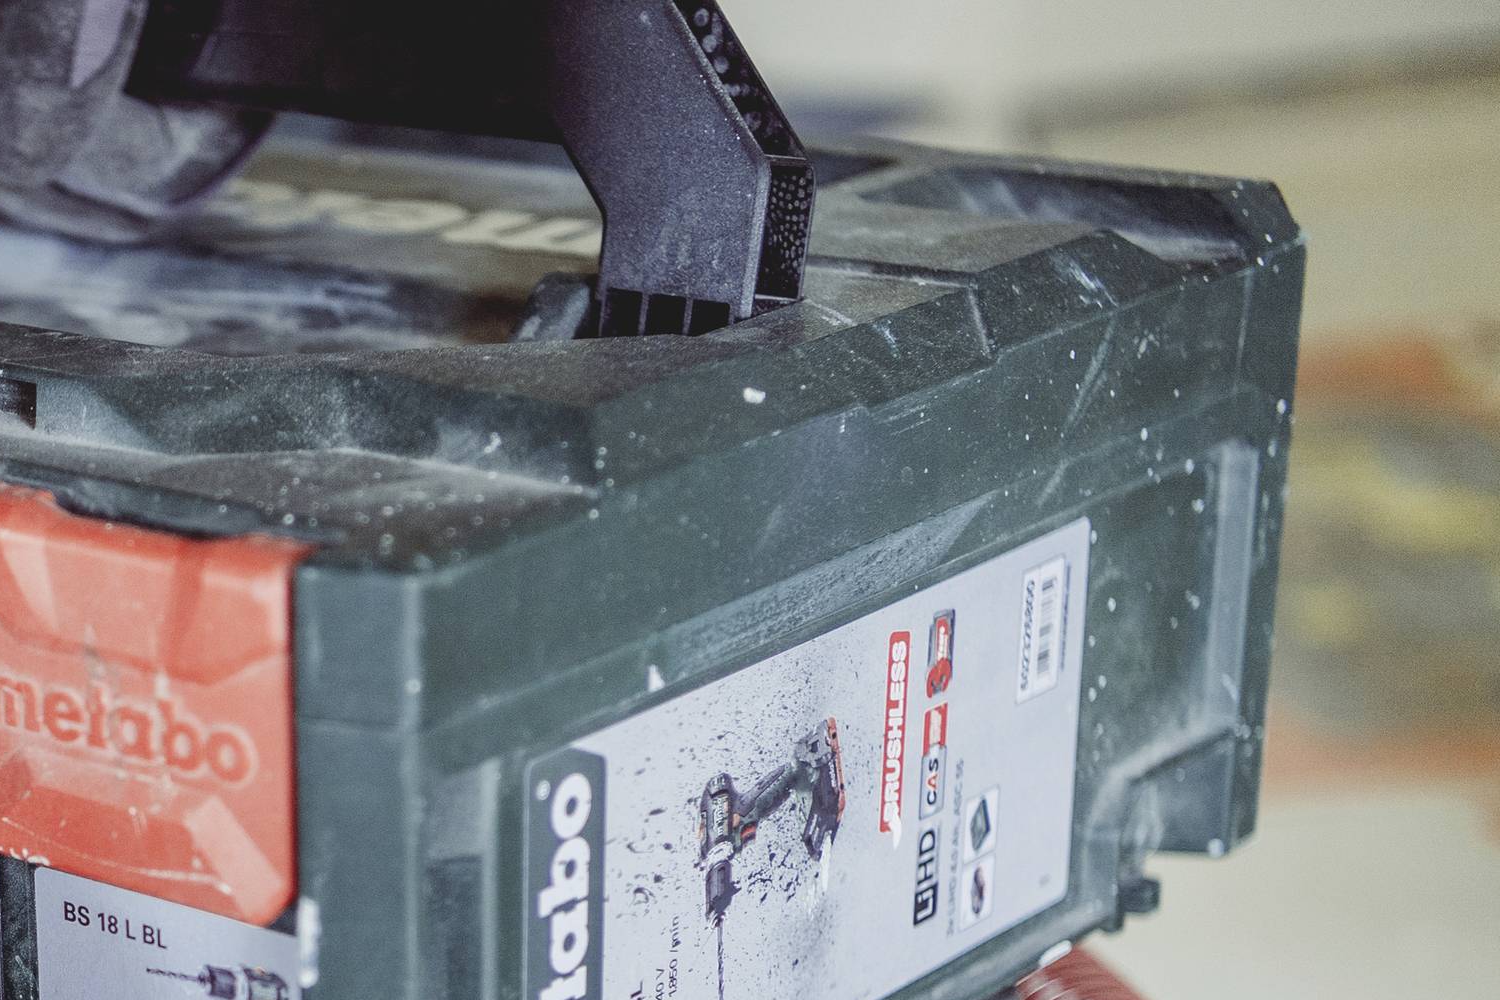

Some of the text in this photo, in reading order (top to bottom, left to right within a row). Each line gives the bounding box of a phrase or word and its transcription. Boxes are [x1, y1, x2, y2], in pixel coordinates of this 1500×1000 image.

[883, 640, 907, 826] BRUSHLESS
[926, 758, 939, 806] CAS
[63, 900, 168, 950] BS 18 L BL
